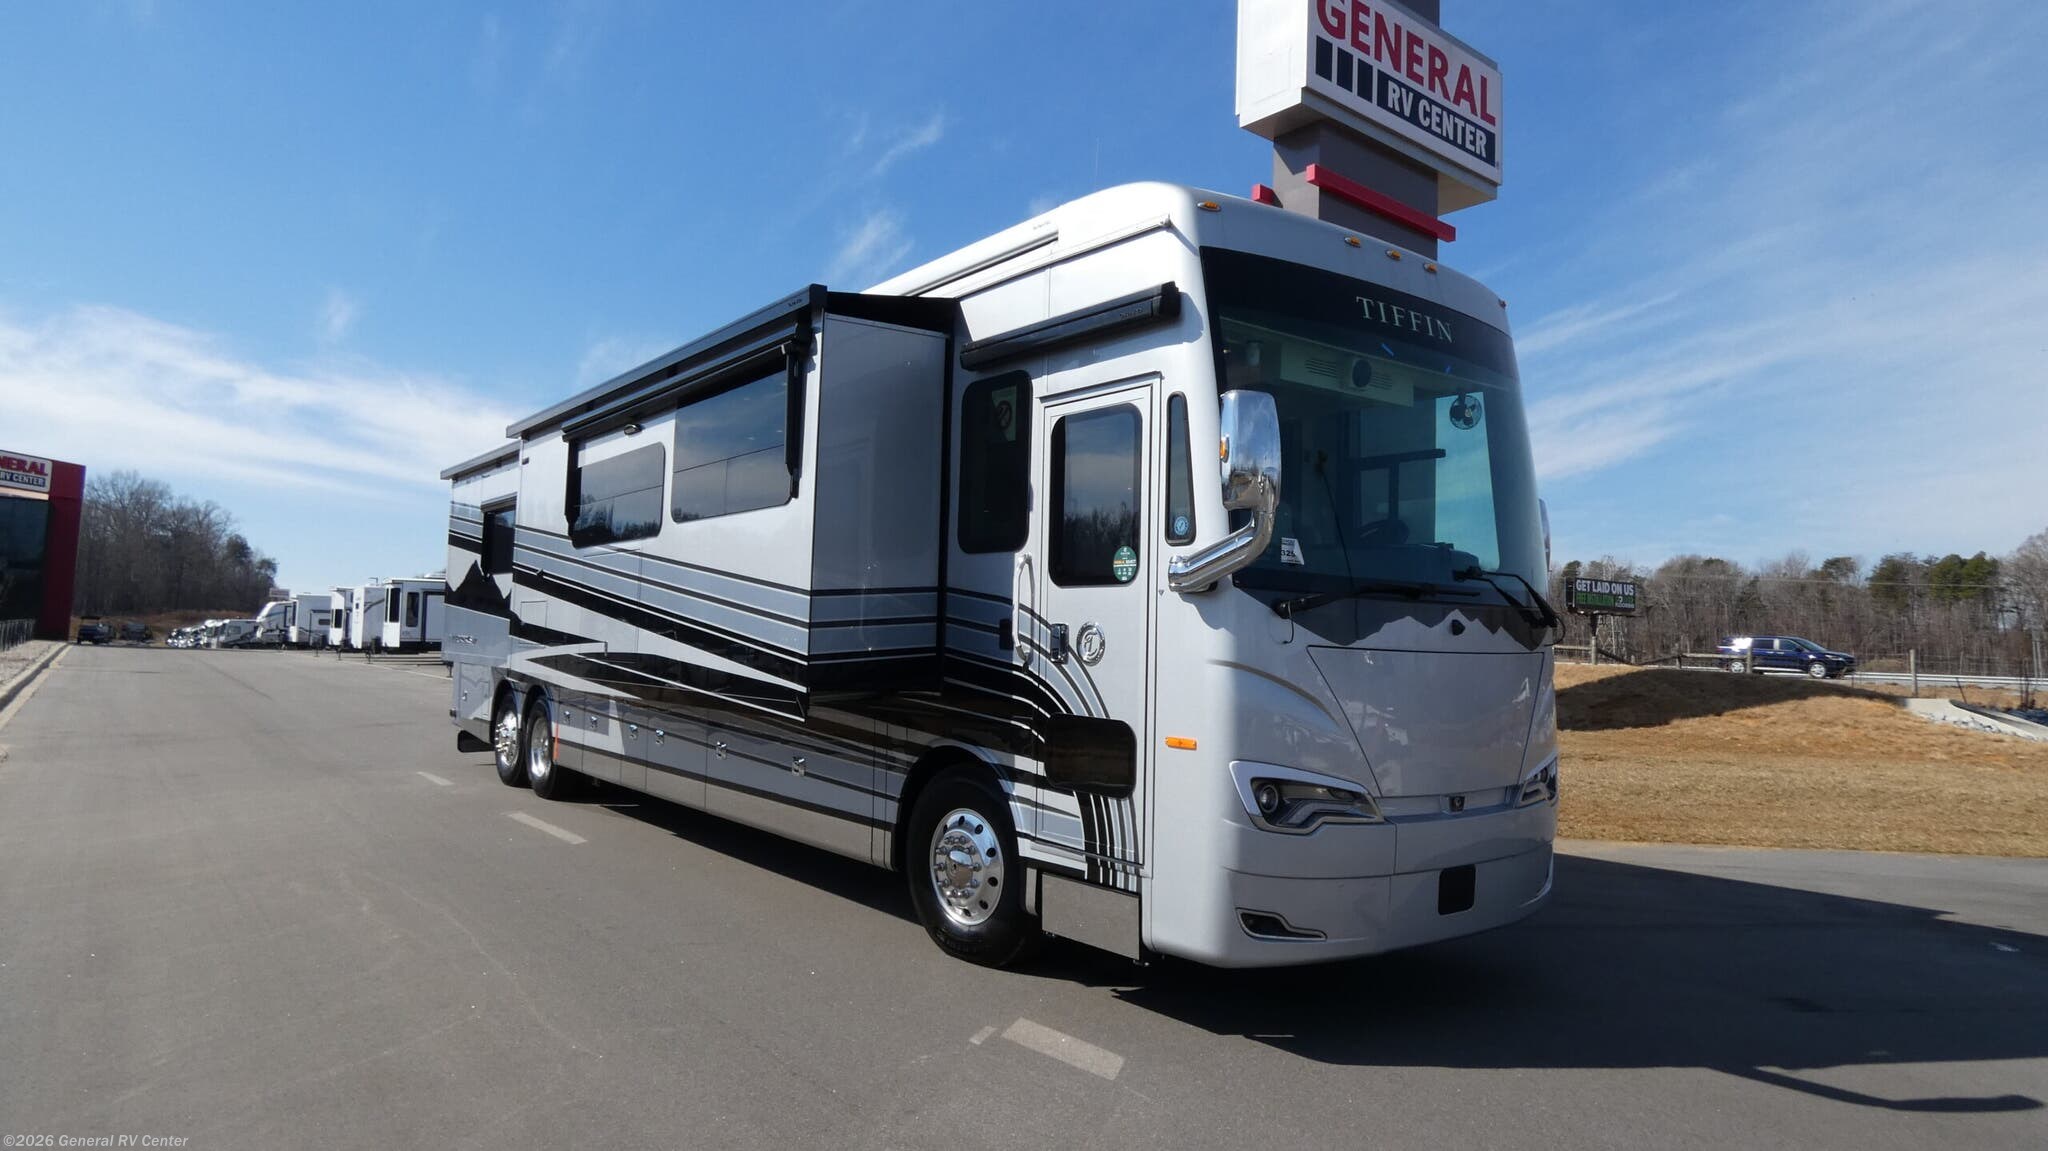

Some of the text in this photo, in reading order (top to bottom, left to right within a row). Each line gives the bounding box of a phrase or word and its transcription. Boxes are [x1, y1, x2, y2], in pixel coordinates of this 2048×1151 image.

[1316, 0, 1496, 127] GENERAL
[1387, 79, 1488, 158] RV CENTER
[1356, 296, 1453, 343] TIFFIN
[13, 474, 45, 487] CENTER
[1576, 579, 1634, 596] GET LAID ON US
